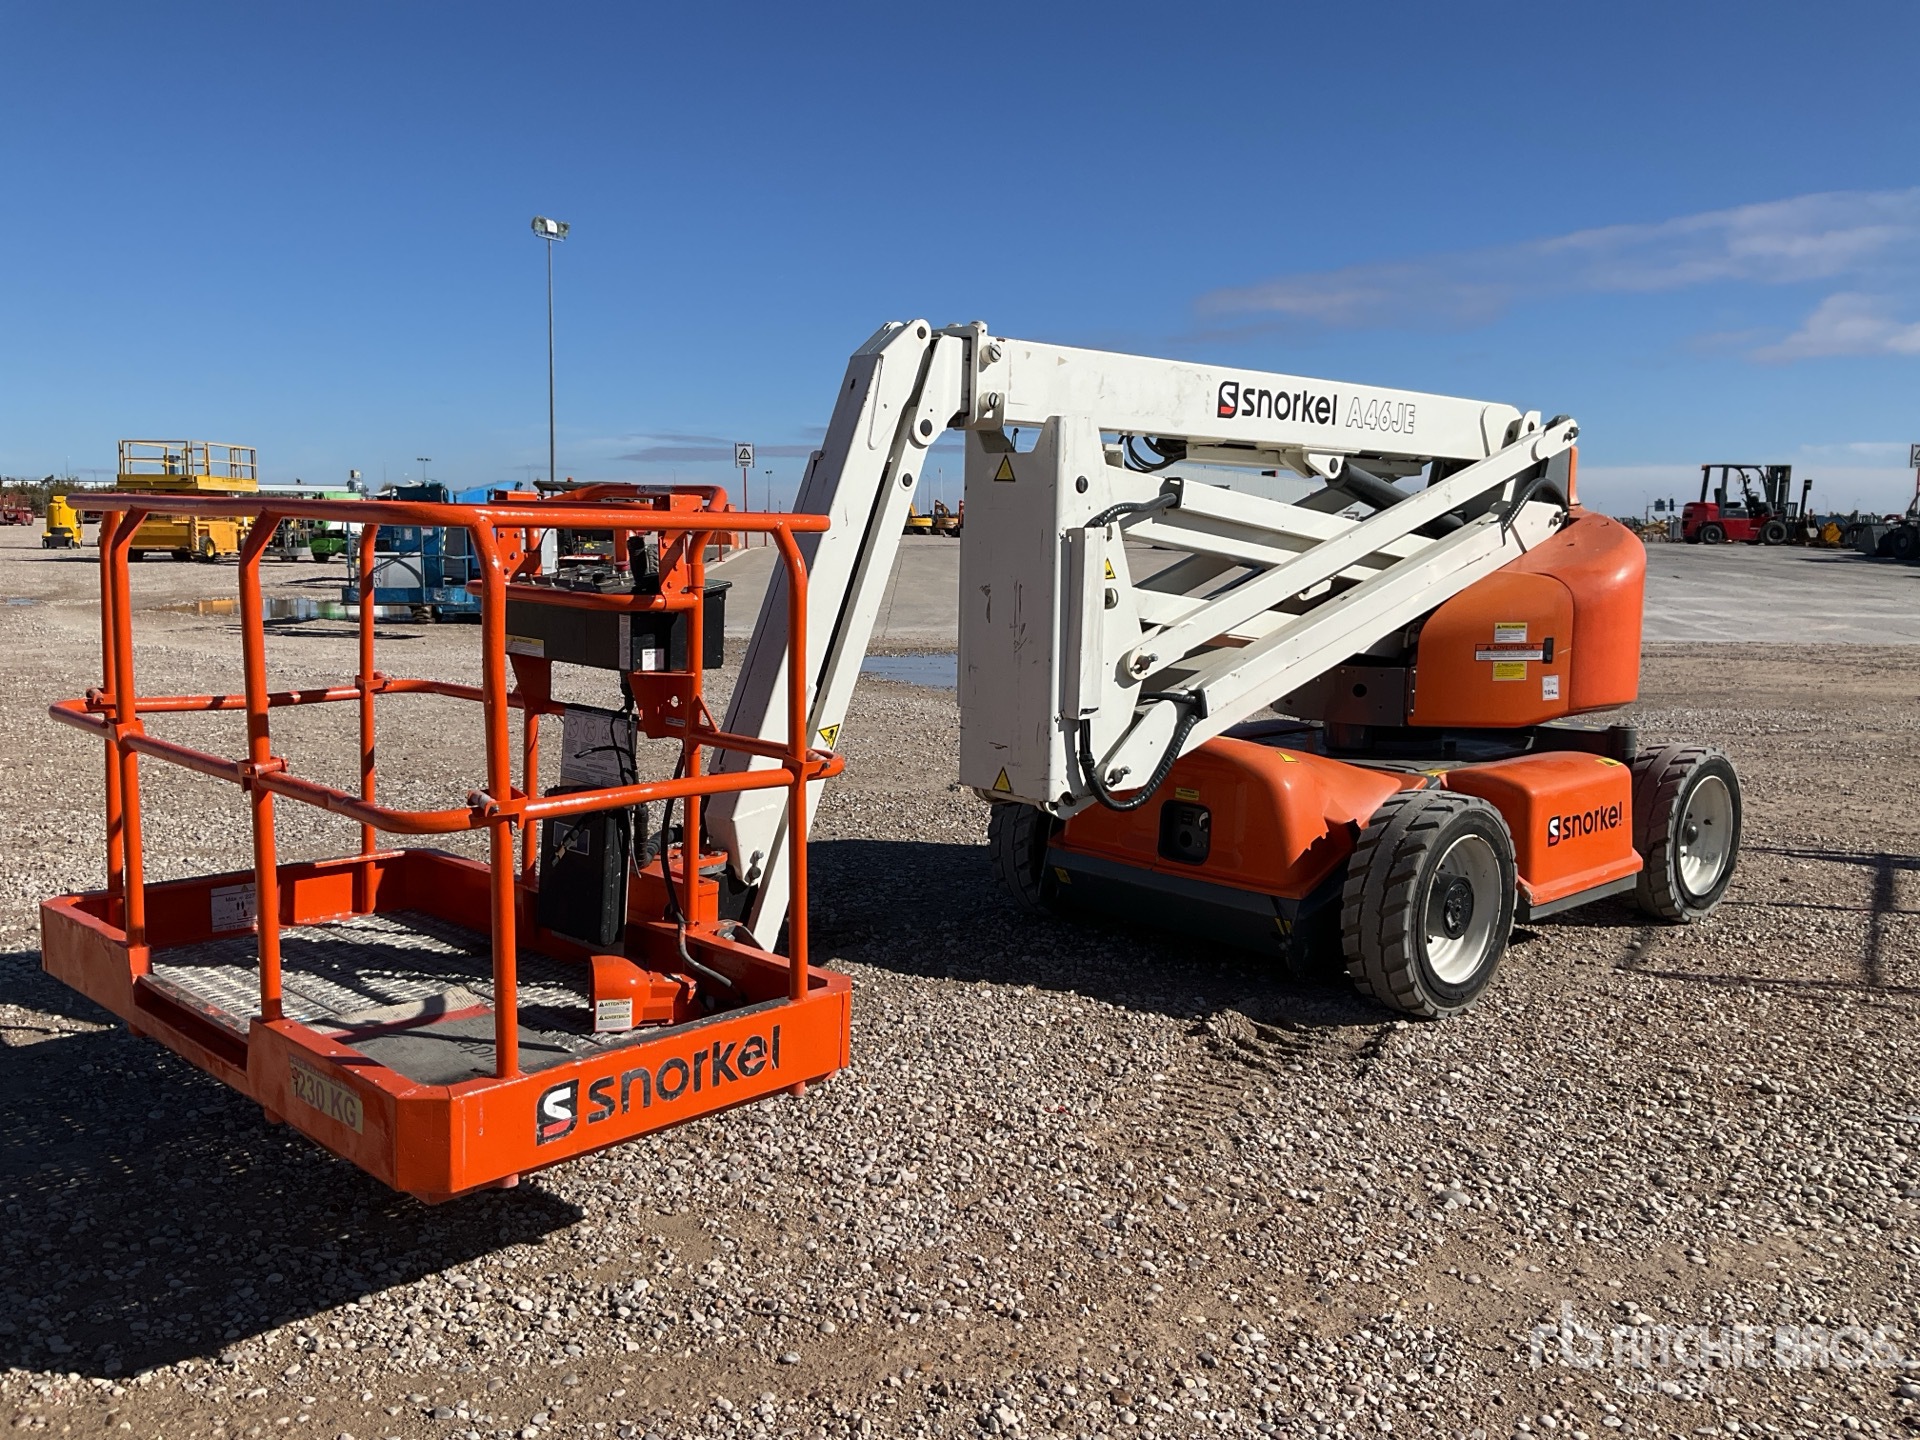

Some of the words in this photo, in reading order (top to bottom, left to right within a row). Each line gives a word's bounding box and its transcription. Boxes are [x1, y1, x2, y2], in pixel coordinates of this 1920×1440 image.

[1241, 388, 1338, 426] snorkel
[1345, 396, 1416, 435] A46JE
[1562, 801, 1623, 840] snorkel
[297, 1070, 326, 1111] 230
[330, 1087, 357, 1128] KG
[587, 1024, 782, 1125] snorkel
